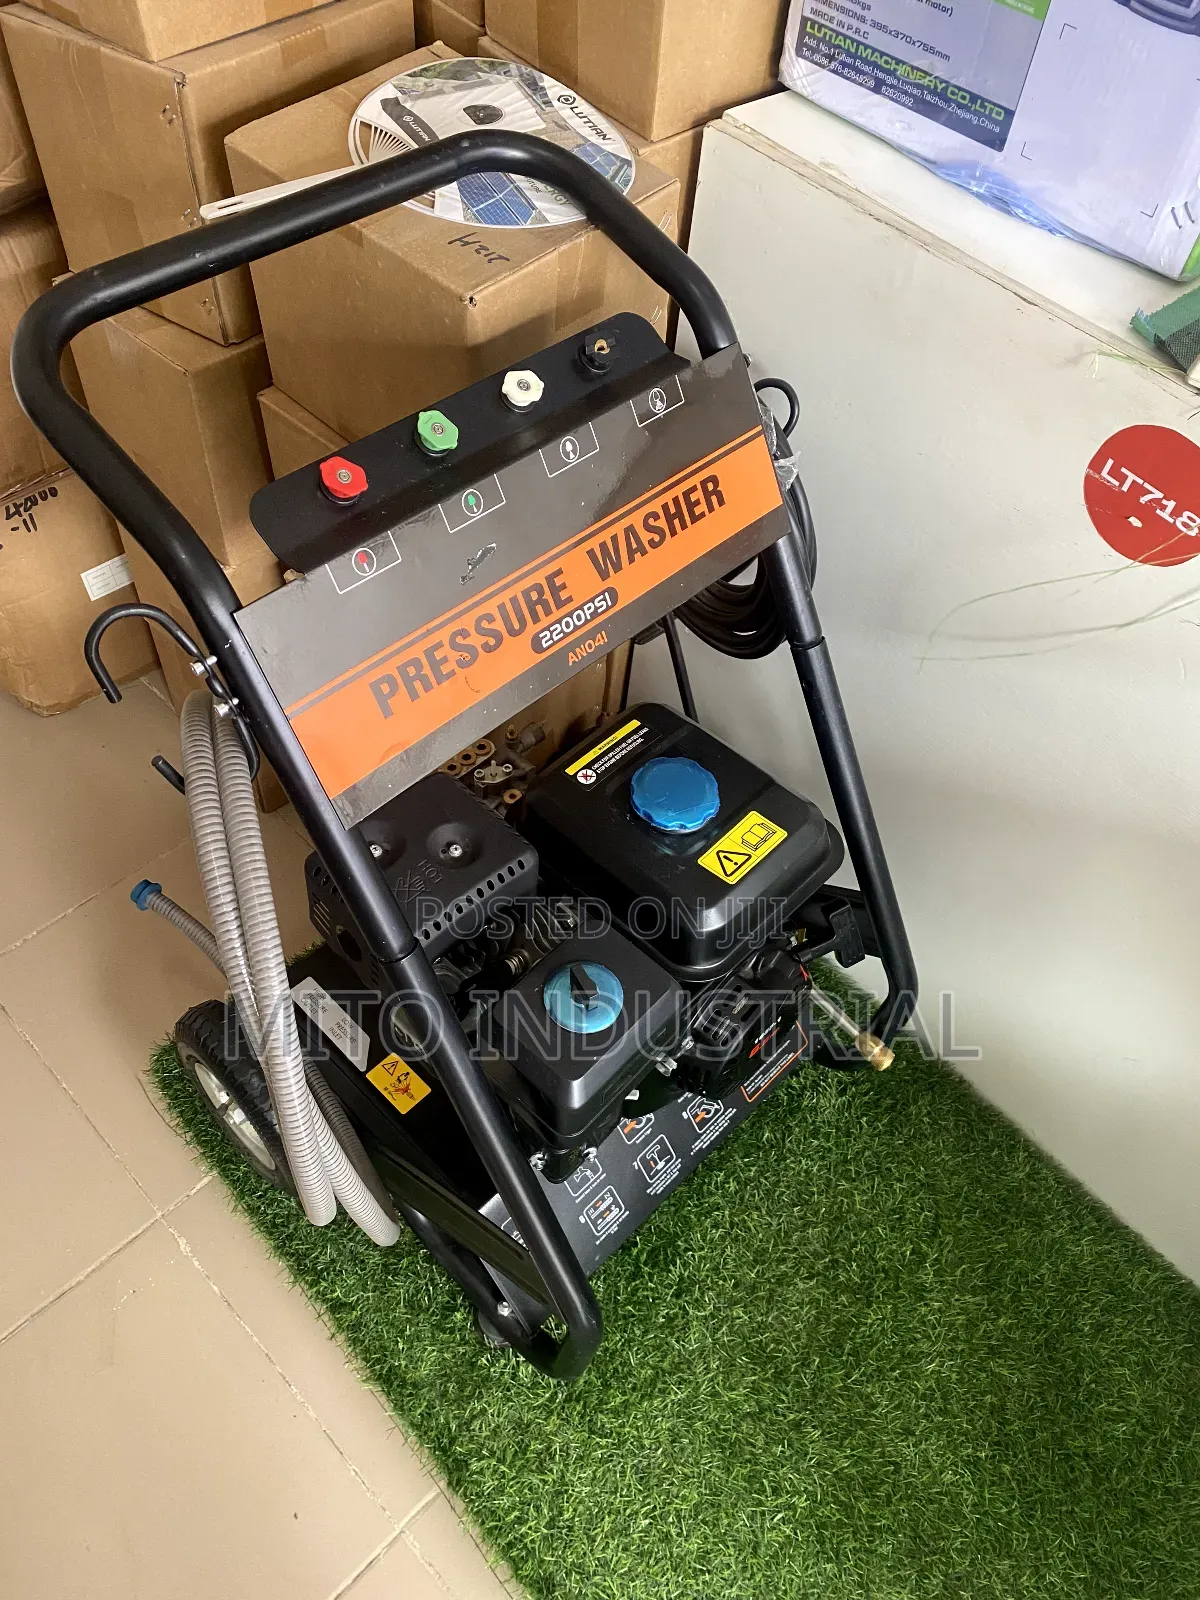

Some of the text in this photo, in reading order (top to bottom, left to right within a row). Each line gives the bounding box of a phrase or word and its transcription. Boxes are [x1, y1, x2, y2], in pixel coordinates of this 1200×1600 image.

[810, 7, 870, 40] MADE IN P.R.C
[813, 0, 951, 62] MENSIONS: 395x370x755mm
[806, 20, 1005, 120] LUTIAN MACHINERY CO.,LTD
[409, 120, 431, 142] LUTIAN
[568, 105, 613, 143] LUTIAN
[1099, 457, 1200, 537] LT718
[368, 473, 726, 720] PRESSURE WASHER
[538, 591, 612, 649] 2200PSI
[328, 1026, 343, 1041] INLET
[334, 1021, 357, 1045] PRESSURE
